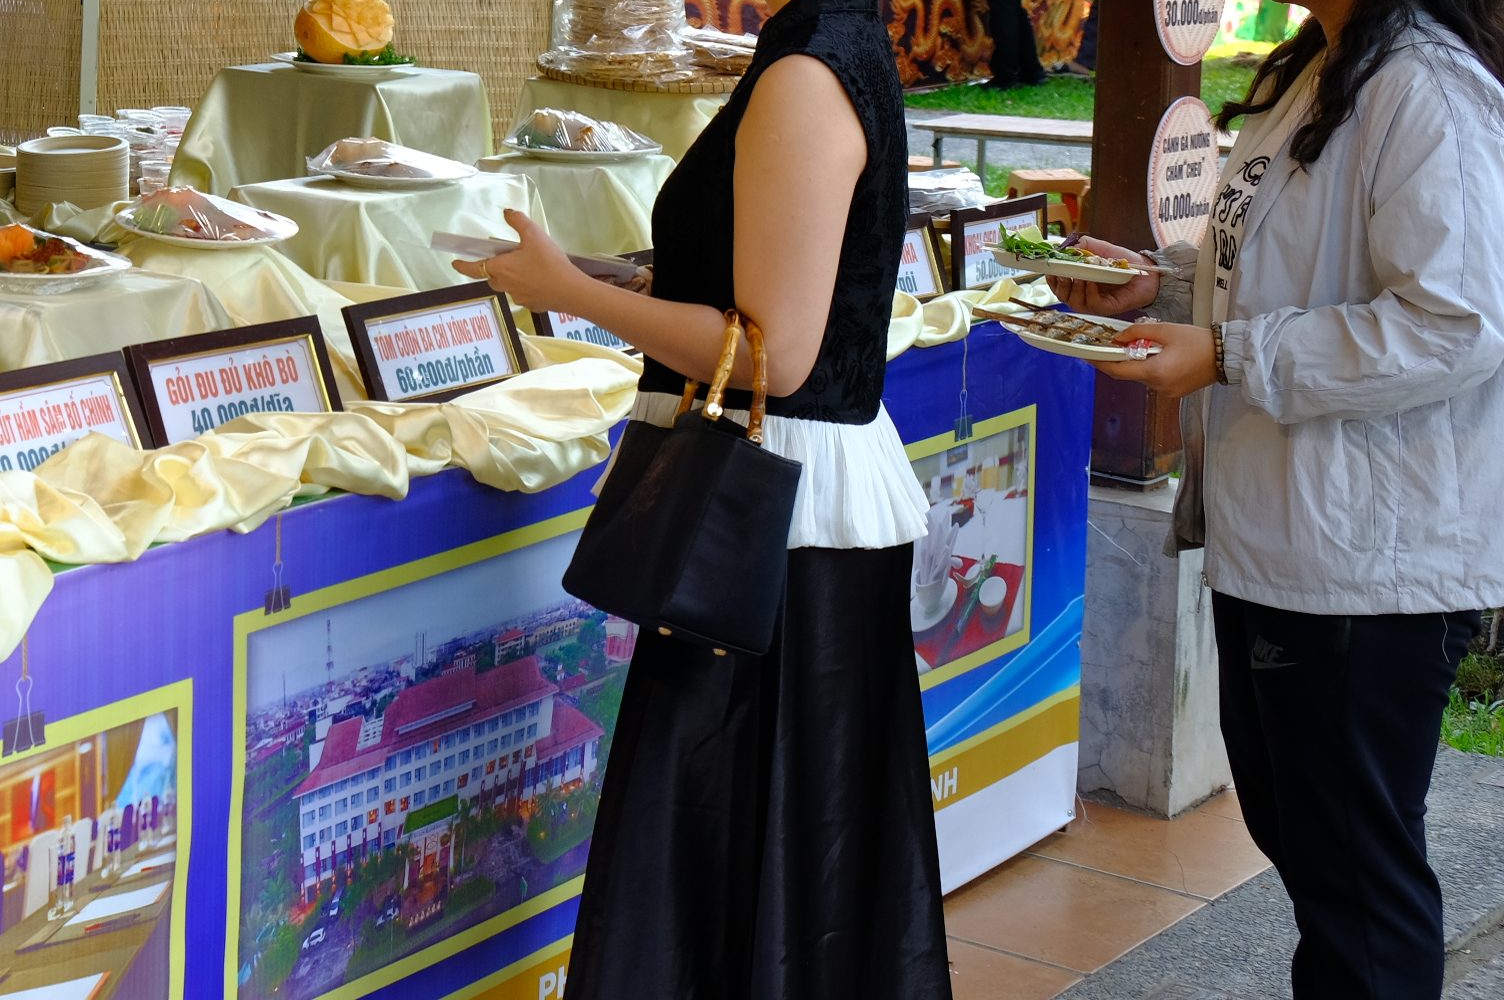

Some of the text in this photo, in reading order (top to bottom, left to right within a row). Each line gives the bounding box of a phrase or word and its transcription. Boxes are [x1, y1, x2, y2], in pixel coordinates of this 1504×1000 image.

[394, 325, 422, 361] CUỘN
[418, 327, 436, 353] BA
[432, 315, 451, 350] CHỈ
[446, 316, 474, 347] XÔNG
[469, 310, 494, 342] KHÓI
[165, 350, 299, 406] GỎI ĐU ĐỦ KHÔ BÒ
[396, 346, 495, 394] 60.000đ/phần
[64, 391, 83, 430] BỐ
[80, 391, 116, 427] CHÍNH
